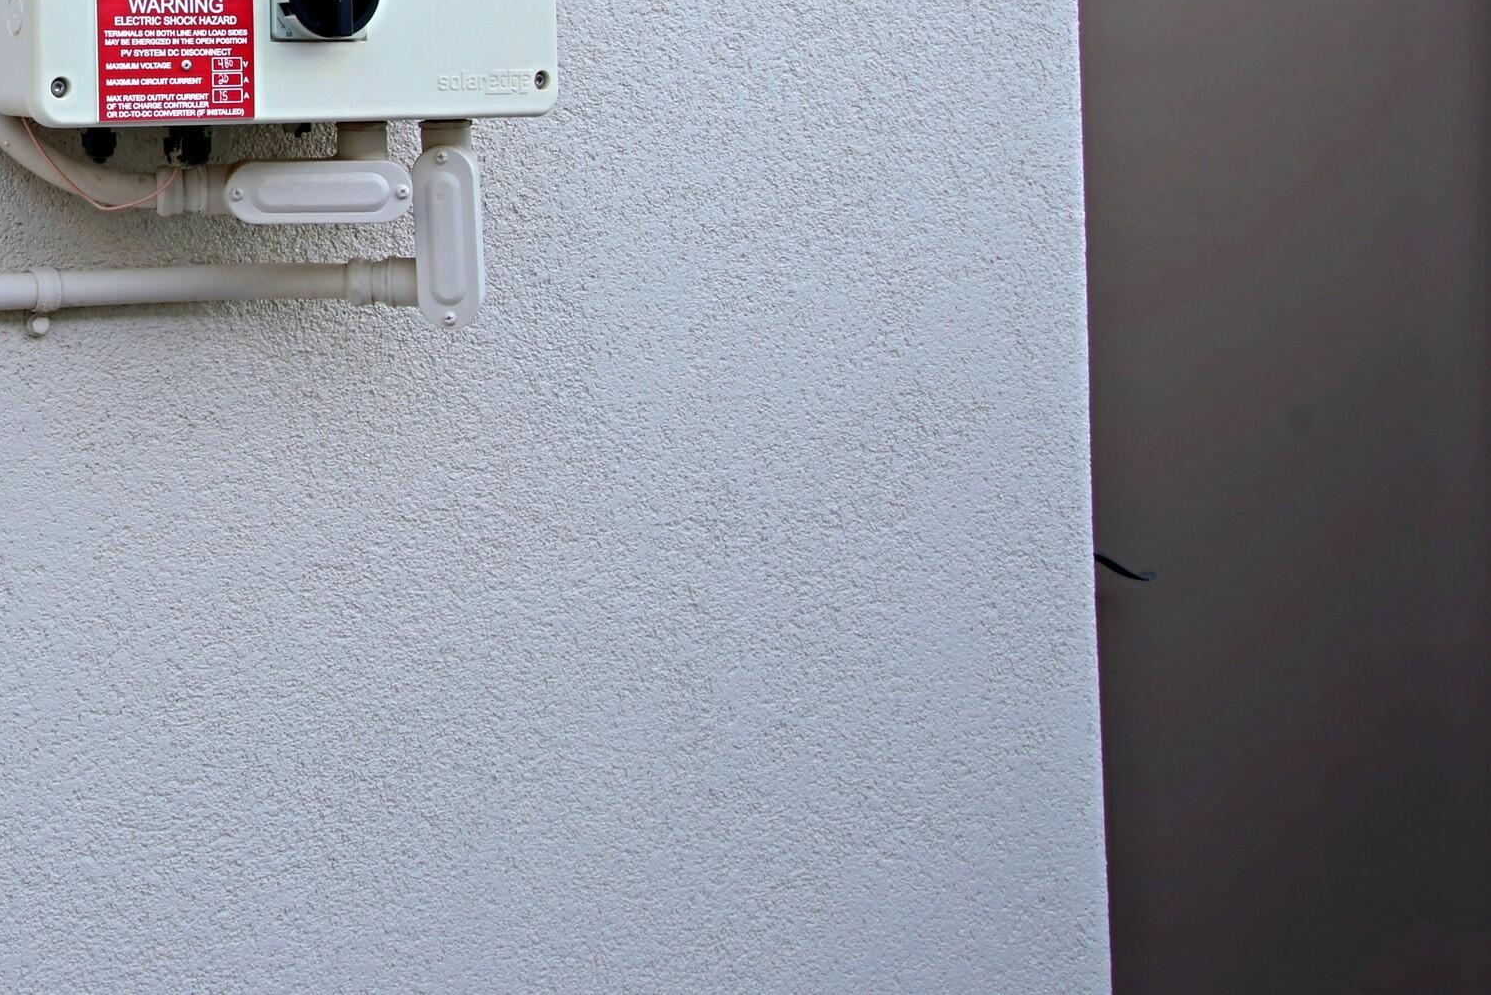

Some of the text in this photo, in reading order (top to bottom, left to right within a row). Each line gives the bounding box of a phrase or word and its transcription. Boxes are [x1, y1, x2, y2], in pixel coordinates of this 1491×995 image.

[114, 16, 237, 26] ELECTRIC SHOCK HAZARD
[181, 48, 232, 56] DISCONNECT
[437, 70, 532, 93] solaredge
[197, 109, 206, 117] (IF
[207, 108, 244, 116] INSTALLED)
